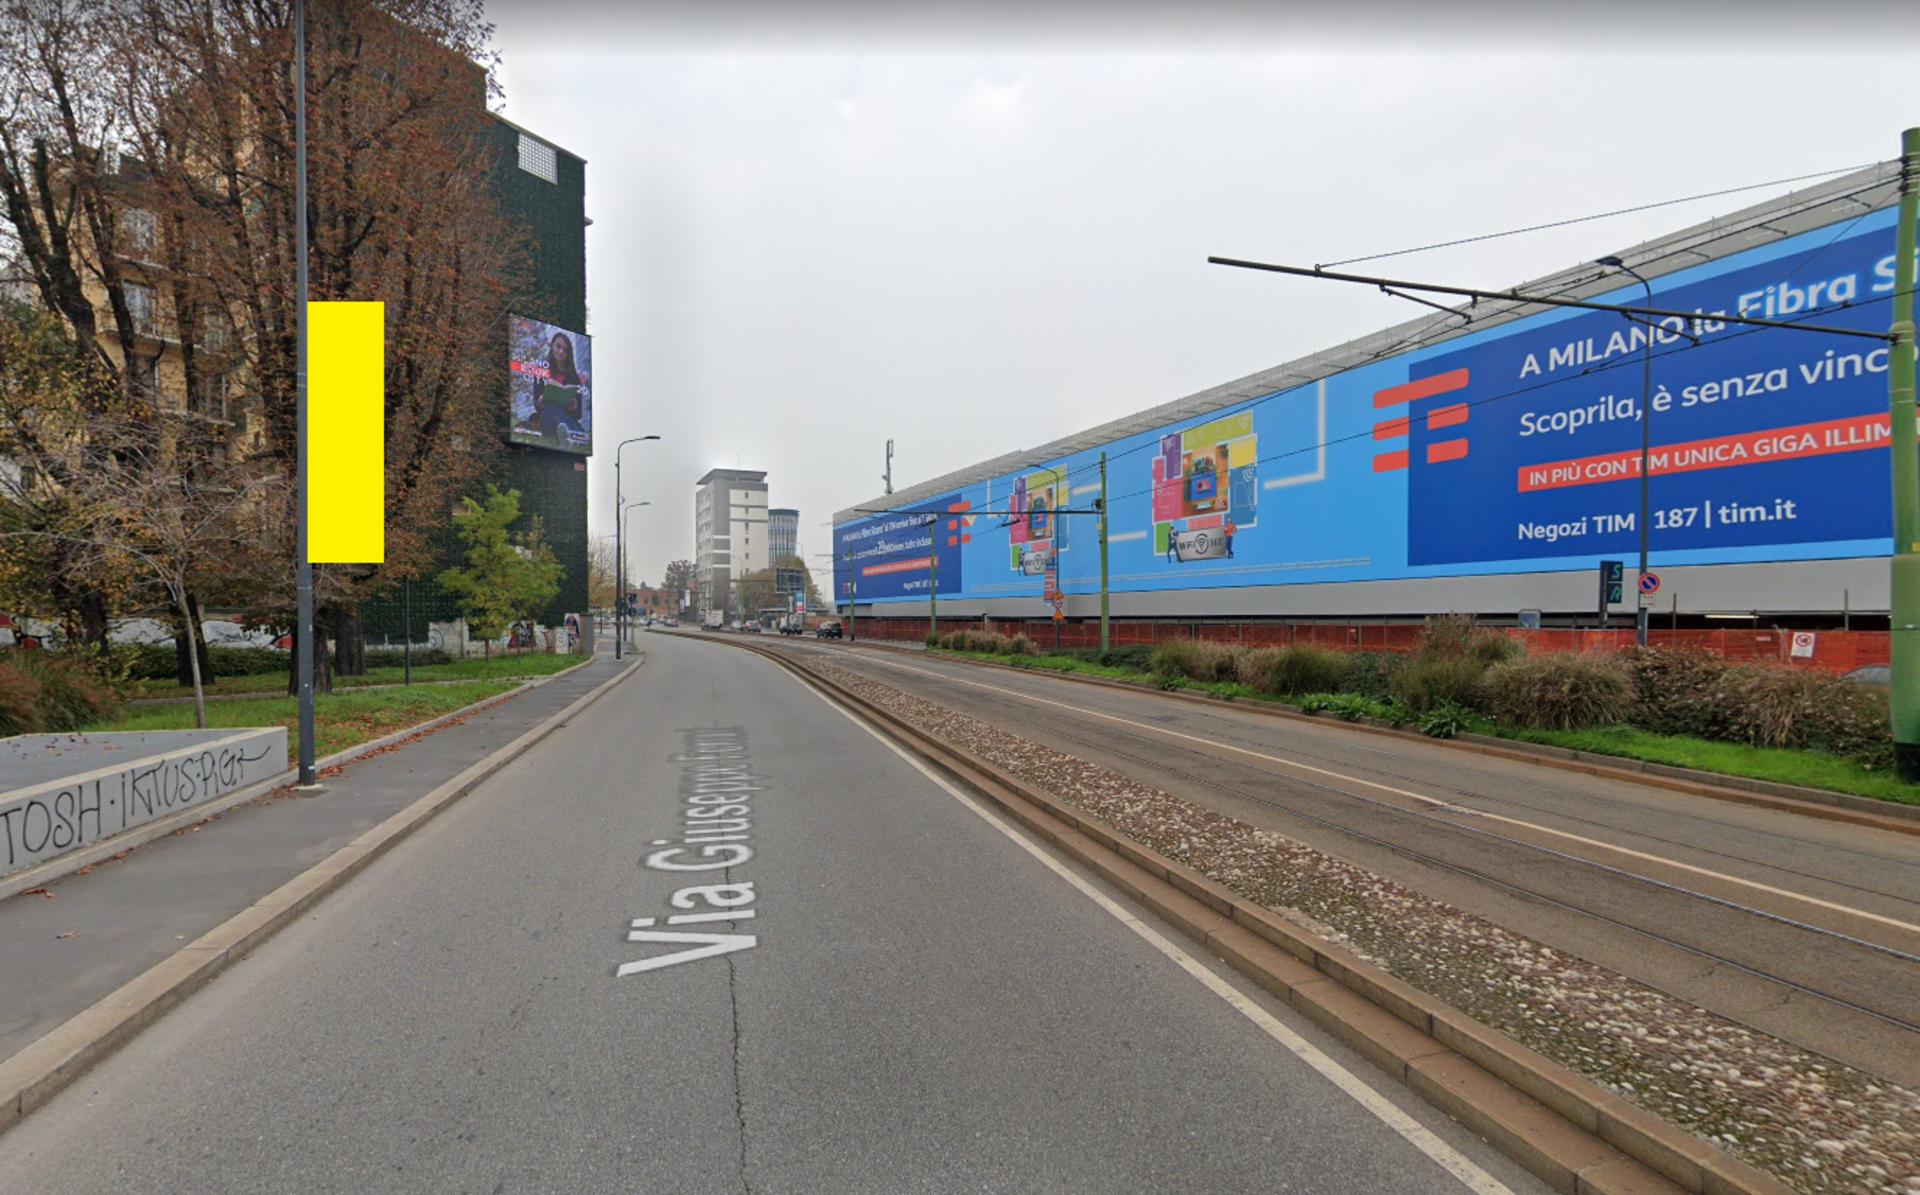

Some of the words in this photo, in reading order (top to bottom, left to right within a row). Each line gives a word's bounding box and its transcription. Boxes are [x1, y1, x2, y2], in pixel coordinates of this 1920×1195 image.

[1519, 353, 1542, 379] A
[1549, 316, 1684, 372] MILANO
[1694, 308, 1726, 336] la
[1737, 274, 1857, 326] Fibra
[1519, 395, 1643, 436] Scoprila,
[1652, 384, 1672, 412] è
[1681, 367, 1788, 407] senza
[1800, 345, 1919, 385] vinc
[1529, 471, 1547, 486] IN
[1551, 461, 1581, 483] PIÙ
[1585, 458, 1627, 478] CON
[1631, 452, 1668, 473] TIM
[1674, 442, 1749, 467] UNICA
[1753, 432, 1818, 457] GIGA
[1518, 516, 1587, 542] Negozi
[1592, 512, 1635, 534] TIM
[1654, 507, 1698, 529] 187
[1718, 498, 1797, 525] tim.it
